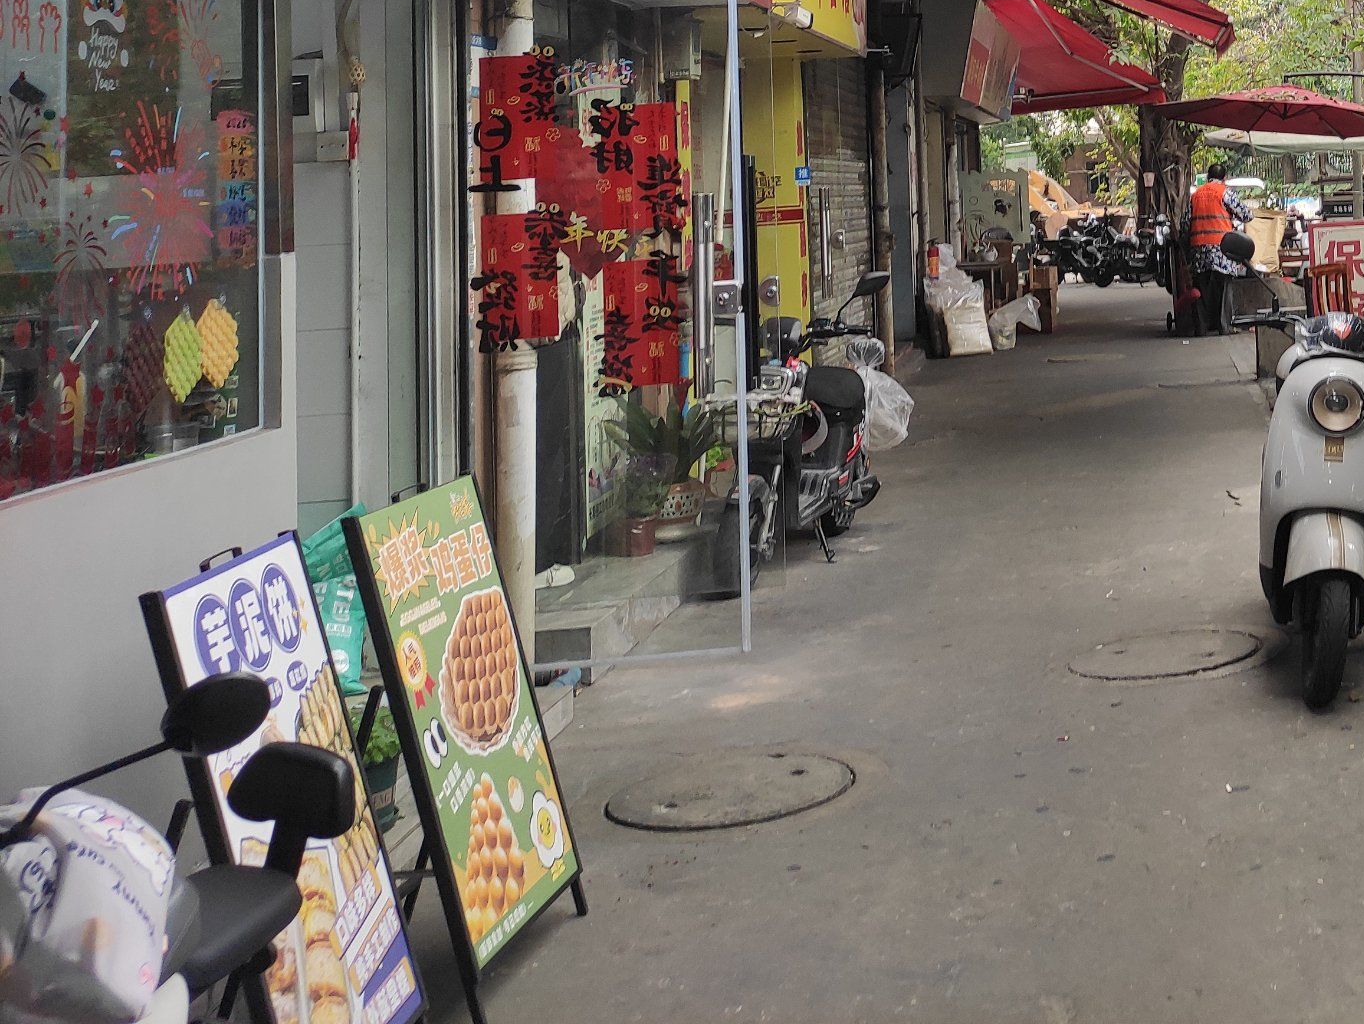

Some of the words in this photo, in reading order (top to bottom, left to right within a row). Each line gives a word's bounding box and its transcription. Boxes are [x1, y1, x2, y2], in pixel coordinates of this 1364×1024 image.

[88, 50, 112, 70] New
[89, 25, 119, 60] Happy
[379, 526, 429, 600] 爆浆
[430, 521, 492, 596] 鸡蛋仔
[200, 576, 300, 675] 芋泥饼
